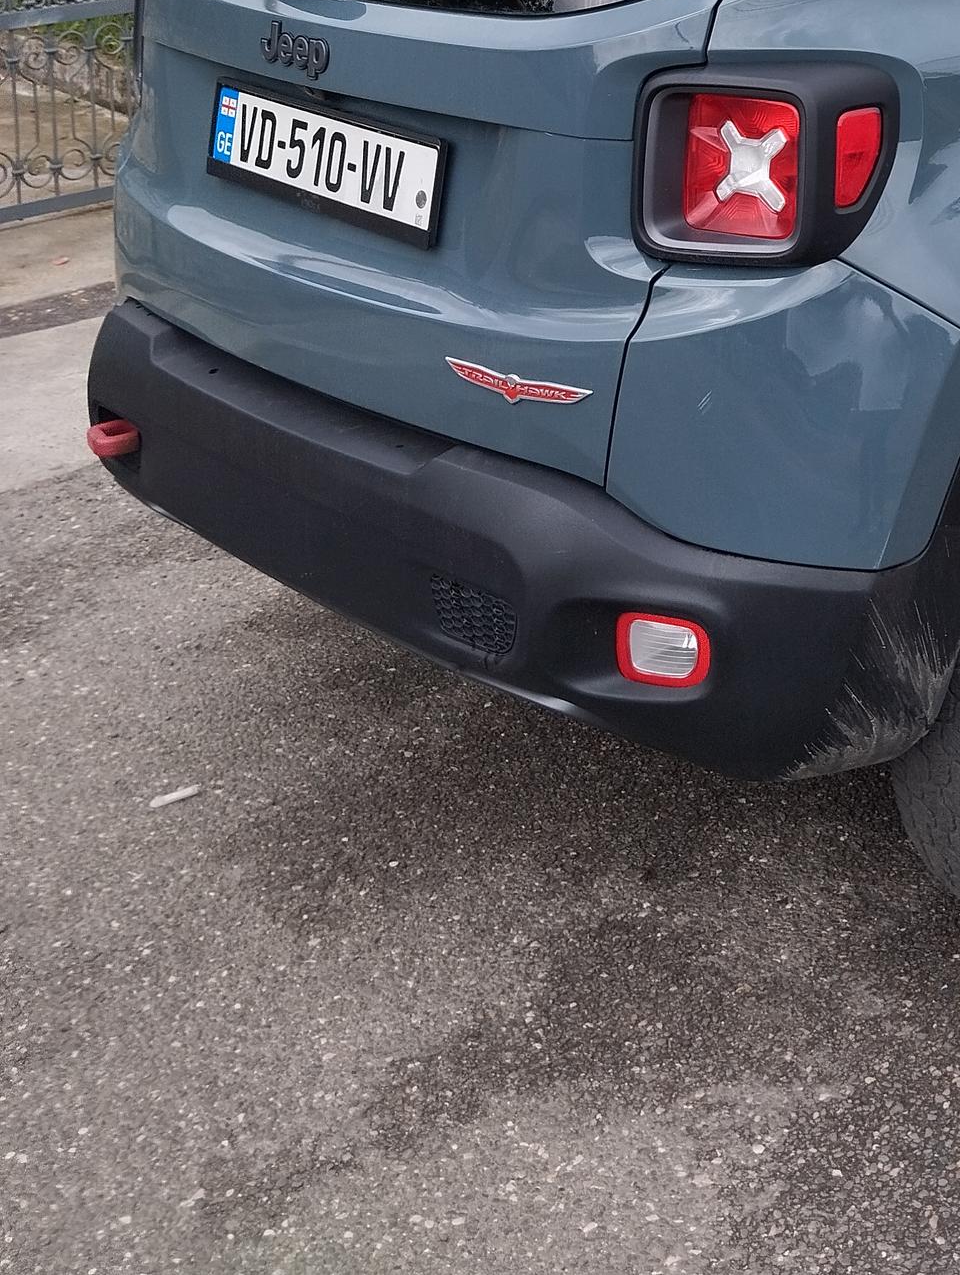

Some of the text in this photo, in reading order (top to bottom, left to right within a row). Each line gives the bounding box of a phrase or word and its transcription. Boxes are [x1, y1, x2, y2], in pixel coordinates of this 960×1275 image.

[259, 20, 330, 80] Jeep
[217, 131, 233, 155] GE
[239, 103, 406, 212] VD-510-VV
